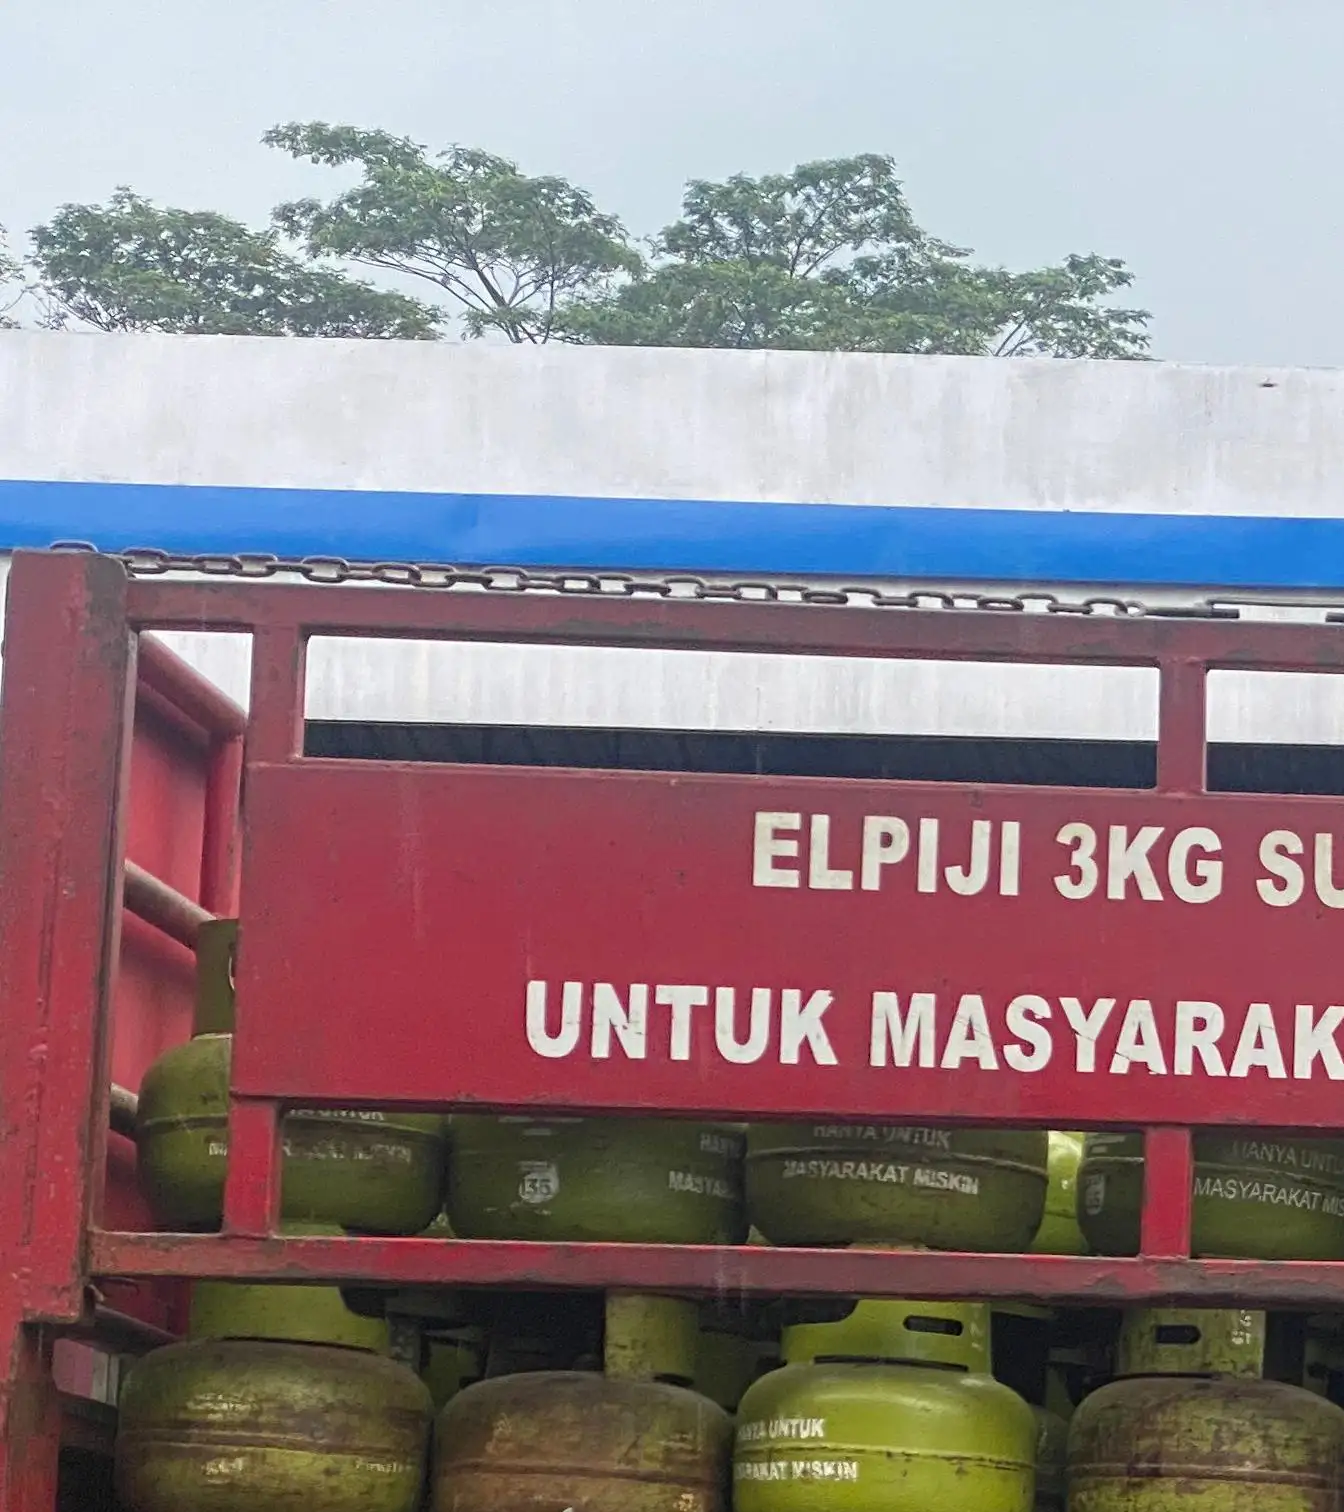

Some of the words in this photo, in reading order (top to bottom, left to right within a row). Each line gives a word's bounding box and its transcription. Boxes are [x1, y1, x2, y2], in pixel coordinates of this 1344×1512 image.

[753, 811, 1020, 896] ELPIJI
[1054, 822, 1223, 904] 3KG
[526, 980, 838, 1068] UNTUK
[782, 1160, 909, 1186] MASYARAKAT
[912, 1168, 980, 1195] MISKIN
[1193, 1177, 1321, 1212] MASYARAKAT
[769, 1418, 825, 1439] UNTUK
